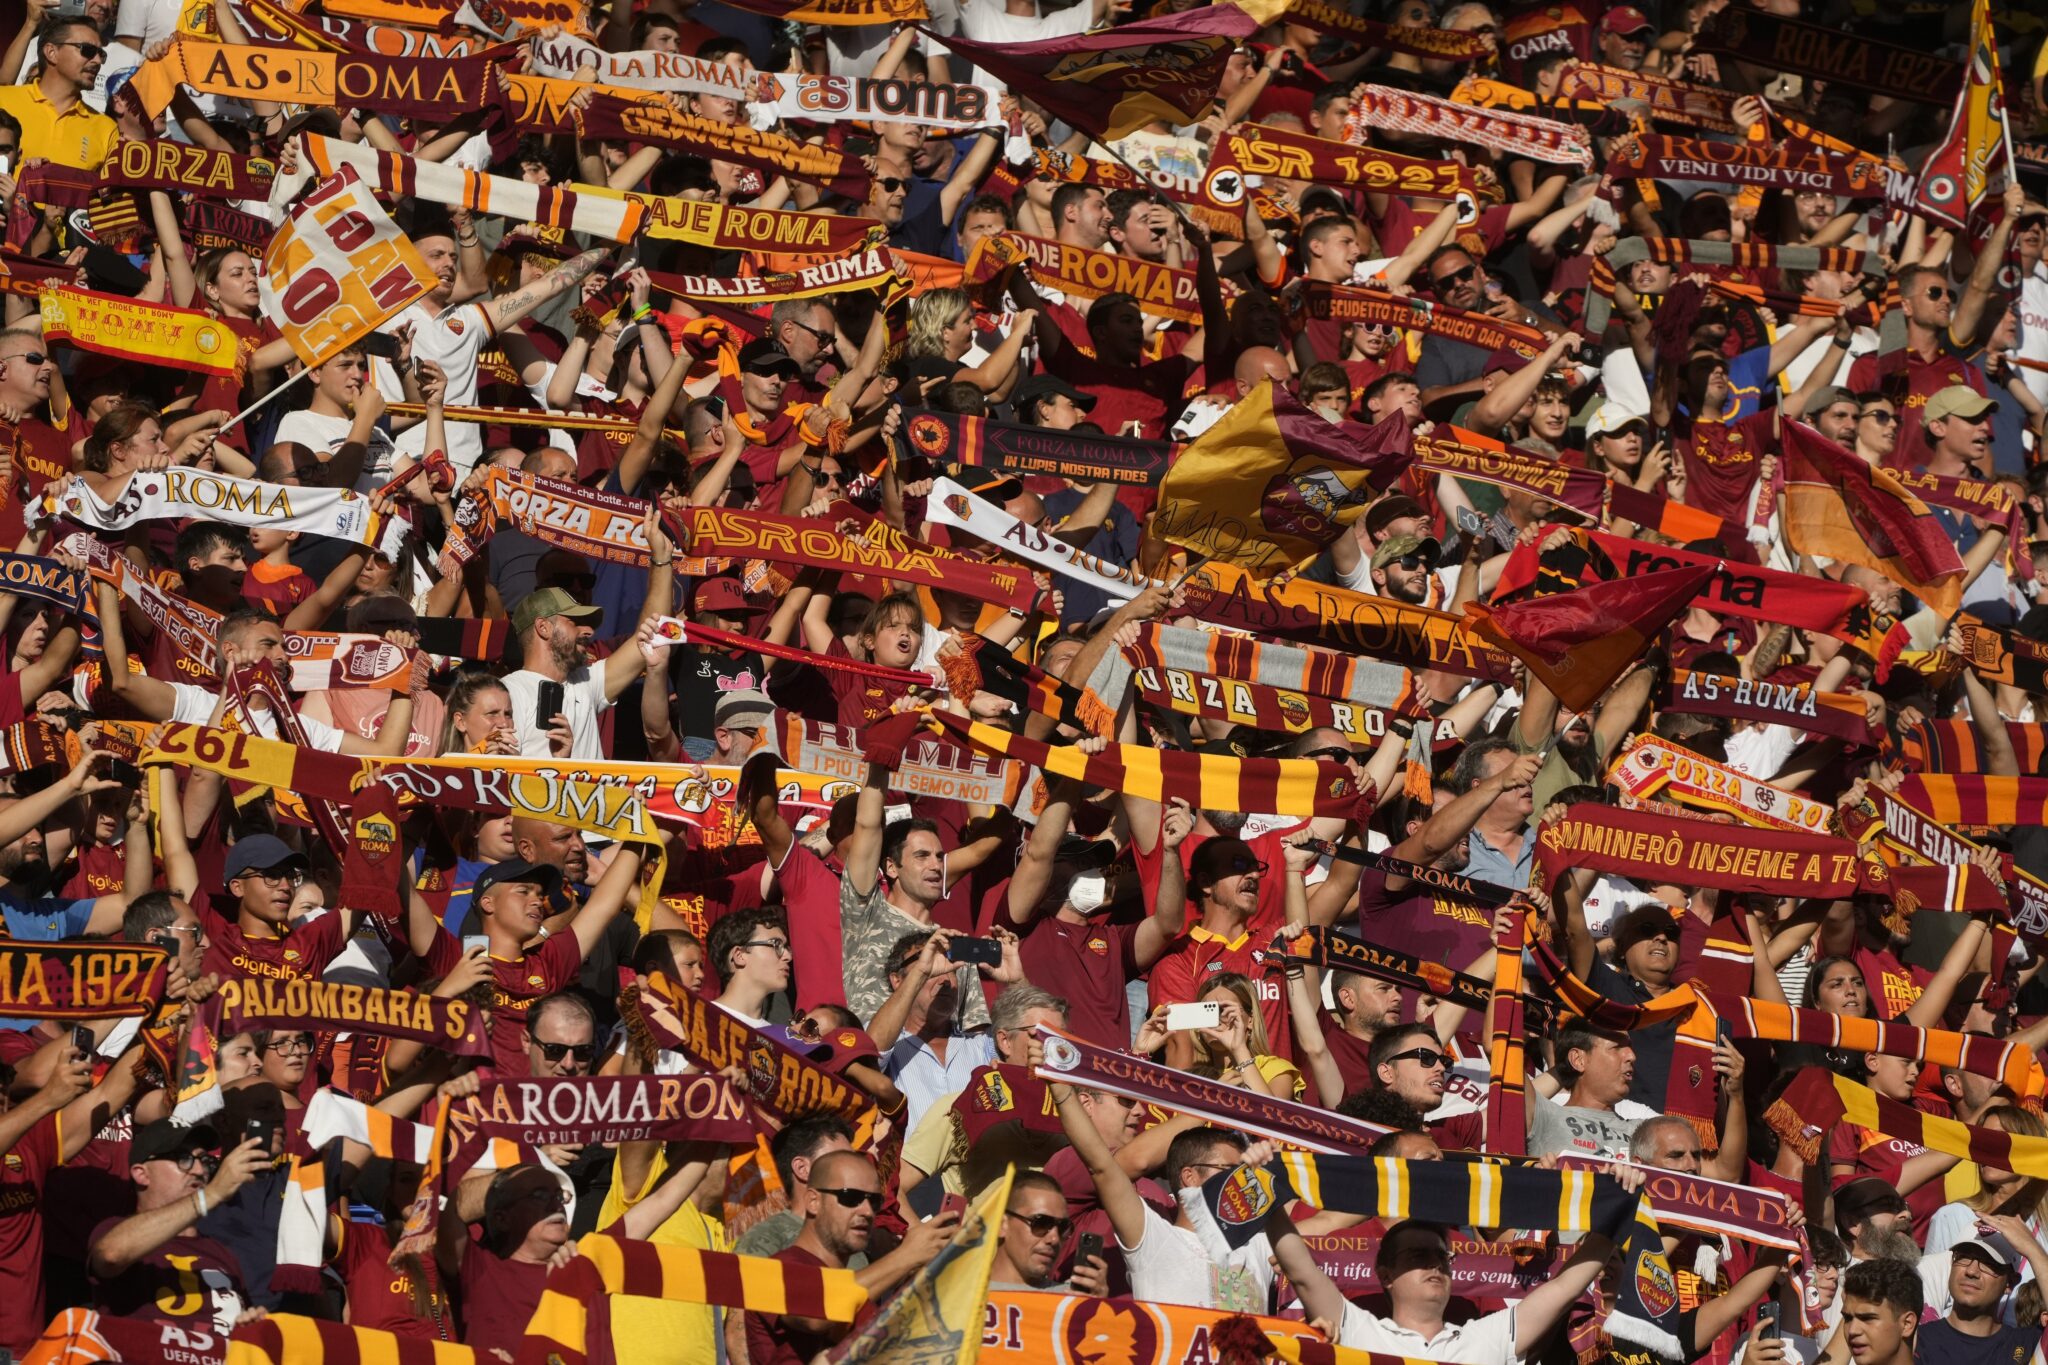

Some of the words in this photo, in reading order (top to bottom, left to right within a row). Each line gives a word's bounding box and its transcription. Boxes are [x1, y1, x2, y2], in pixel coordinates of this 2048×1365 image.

[1510, 29, 1571, 60] QATAR
[1772, 23, 1870, 80] ROMA
[1883, 51, 1954, 94] 1927
[610, 57, 645, 77] LA
[655, 52, 746, 90] ROMA!
[856, 77, 990, 123] roma
[101, 141, 235, 191] FORZA
[1229, 135, 1314, 180] ASR
[1336, 155, 1462, 195] 1927
[1660, 135, 1832, 175] ROMA
[250, 176, 272, 185] ROMA
[1659, 158, 1717, 177] VENI
[1725, 165, 1778, 183] VIDI
[1784, 169, 1834, 189] VICI
[724, 212, 830, 247] ROMA
[684, 275, 766, 296] DAJE
[801, 249, 886, 288] ROMA
[1011, 233, 1061, 269] DAJE
[1060, 244, 1175, 305] ROMA
[1330, 299, 1391, 321] SCUDETTO
[1393, 306, 1408, 323] TE
[494, 369, 518, 384] 2022
[1016, 434, 1079, 457] FORZA
[1082, 441, 1139, 464] ROMA
[1004, 454, 1018, 467] IN
[1020, 456, 1057, 472] LUPIS
[1060, 461, 1110, 480] NOSTRA
[1114, 467, 1149, 483] FIDES
[495, 479, 591, 534] FORZA
[693, 506, 945, 579] ASROMA
[1185, 588, 1213, 601] ROMA
[1331, 703, 1457, 741] ROA
[105, 740, 132, 757] ROMA
[809, 721, 1004, 778] RMA
[910, 777, 954, 796] SEMO
[958, 783, 990, 802] NOI
[1660, 751, 1741, 800] FORZA
[1700, 790, 1743, 810] RAGAZZI
[1746, 808, 1772, 823] DELLA
[1885, 796, 1918, 849] NOI
[360, 840, 391, 854] ROMA
[1690, 840, 1800, 879] INSIEME
[1802, 853, 1821, 881] A
[1832, 855, 1857, 883] TE
[1412, 864, 1476, 896] ROMA
[70, 951, 166, 1006] 1927
[219, 978, 435, 1034] PALOMBARA
[754, 1068, 772, 1083] 1927
[976, 1085, 992, 1111] ROMA
[523, 1129, 580, 1145] CAPUT
[591, 1126, 653, 1144] MUNDI
[1573, 1138, 1597, 1150] OSAKA
[1222, 1201, 1237, 1219] 1927
[1224, 1183, 1248, 1221] ROMA
[1304, 1237, 1370, 1251] NIONE
[1343, 1261, 1372, 1279] tifa
[1640, 1283, 1671, 1308] ROMA
[160, 1325, 215, 1351] AS
